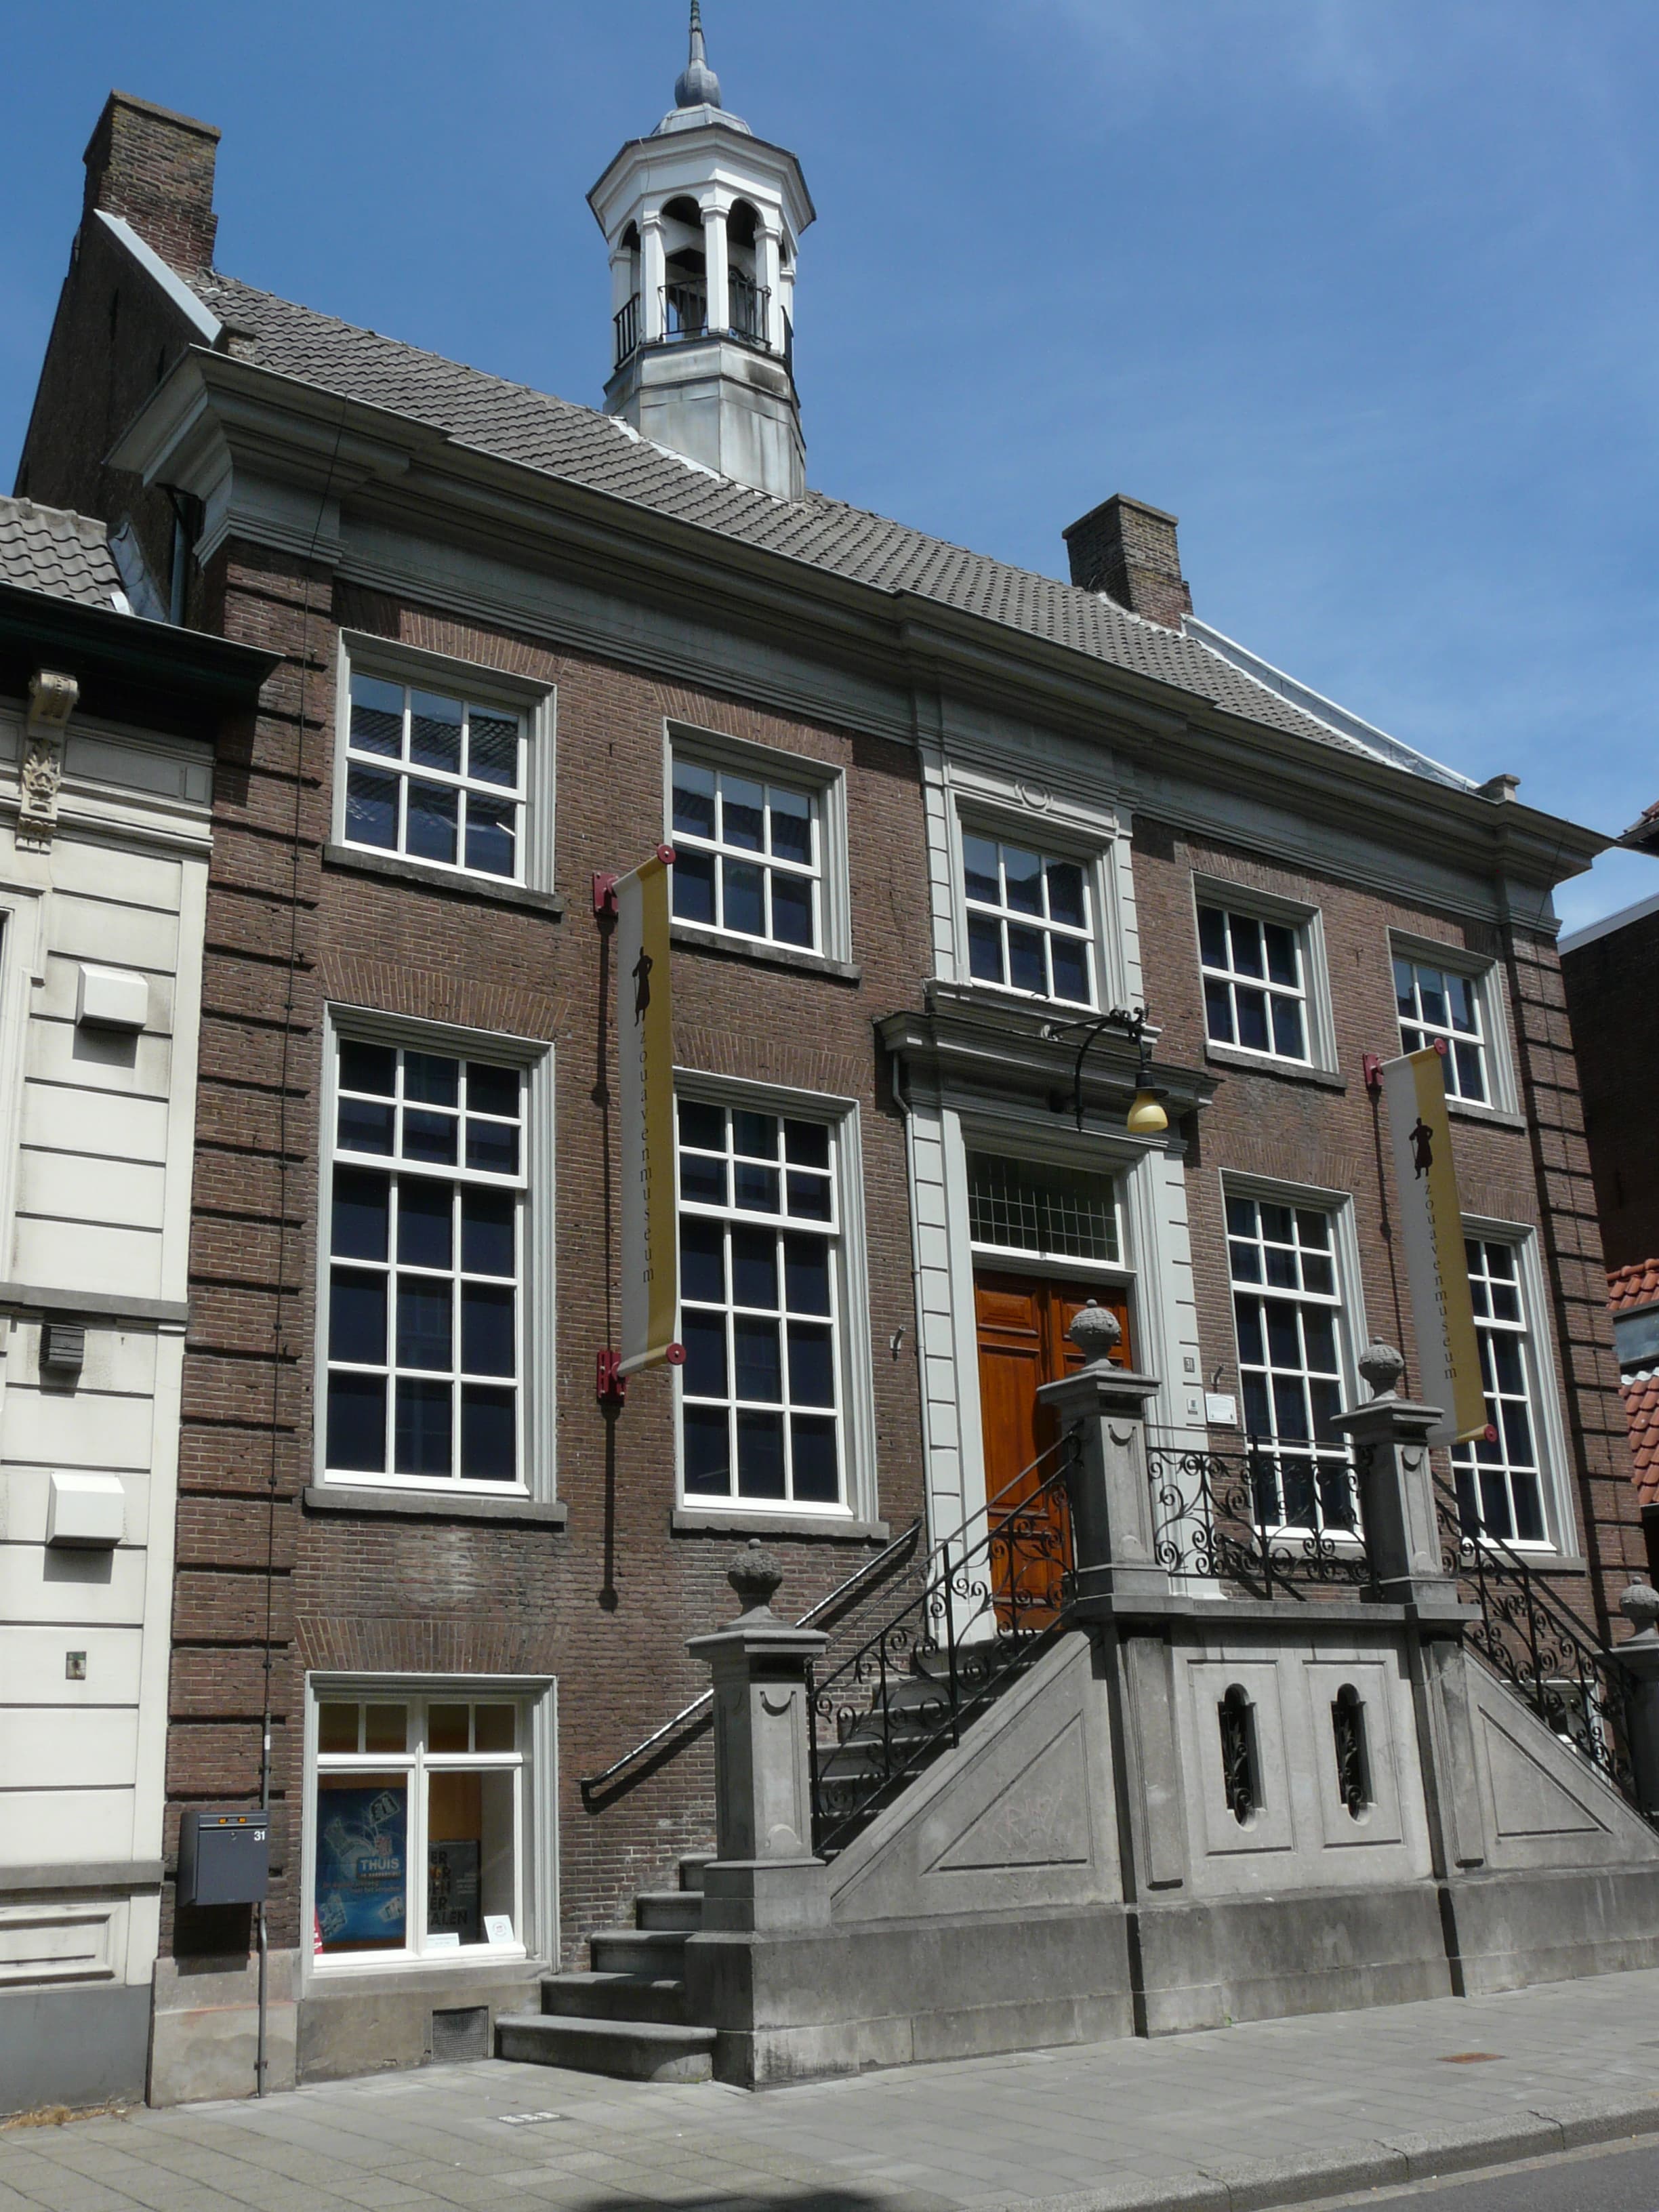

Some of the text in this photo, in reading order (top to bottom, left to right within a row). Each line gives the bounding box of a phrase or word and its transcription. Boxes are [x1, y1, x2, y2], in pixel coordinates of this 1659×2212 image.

[639, 1029, 654, 1282] zouavenmuseum
[1424, 1184, 1457, 1380] zouavenmuseum
[253, 1830, 265, 1841] 31
[360, 1858, 400, 1871] THUIS
